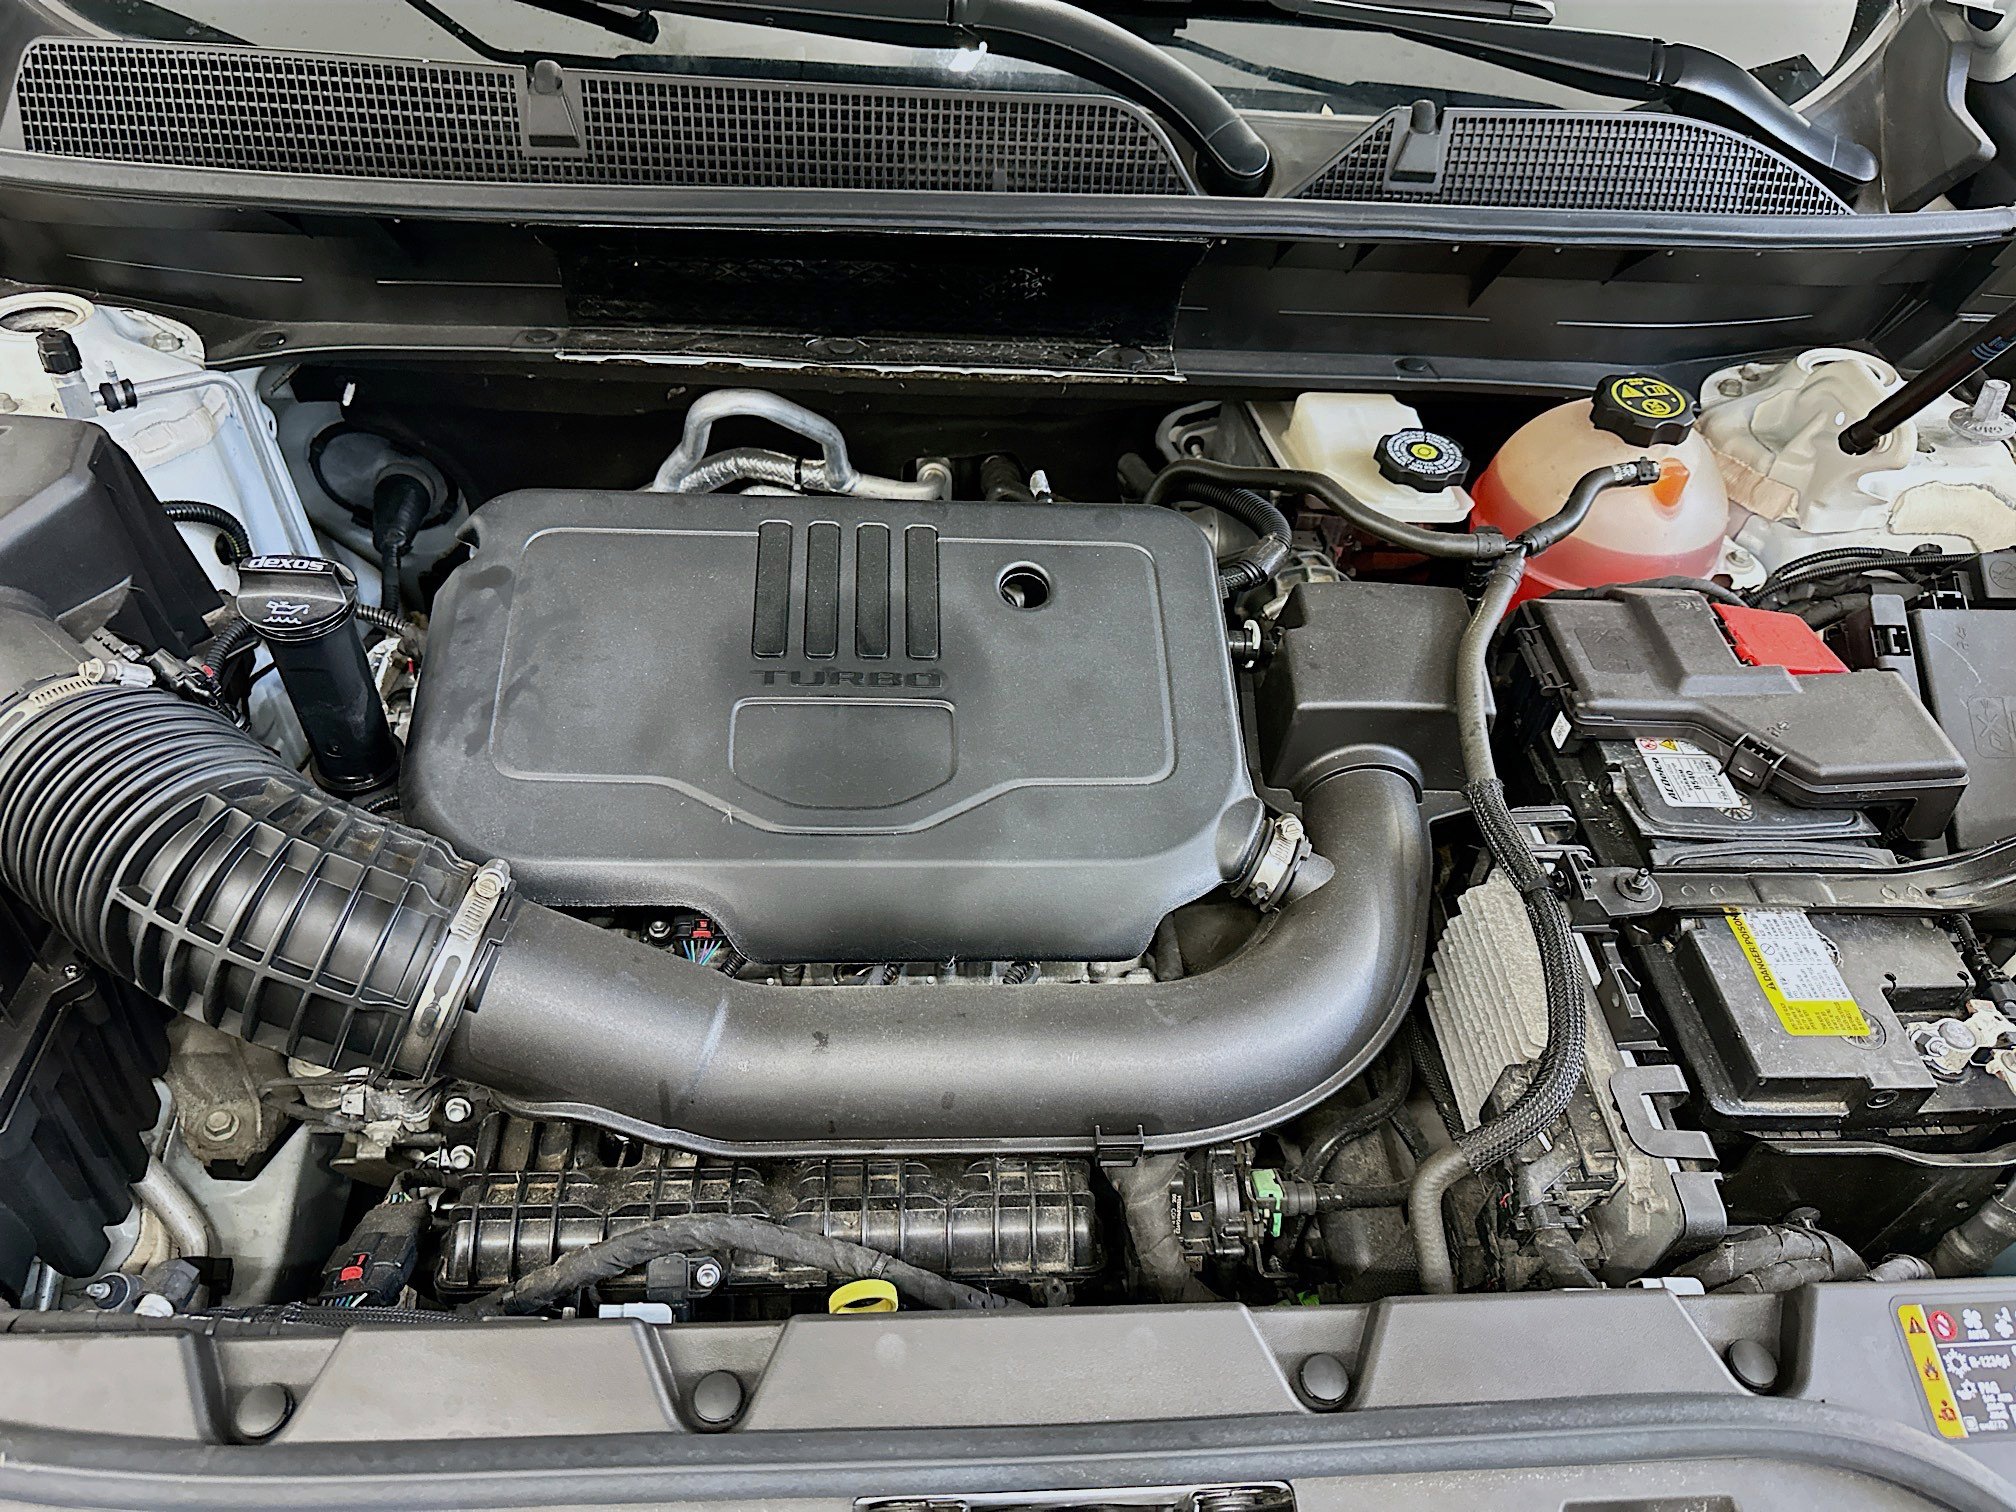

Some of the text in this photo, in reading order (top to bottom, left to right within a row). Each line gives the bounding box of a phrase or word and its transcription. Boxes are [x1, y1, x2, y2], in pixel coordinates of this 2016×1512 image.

[247, 556, 328, 571] dexos
[750, 670, 942, 688] TURBO
[1652, 757, 1678, 800] ACDelco
[1733, 914, 1772, 982] DANGER POISON
